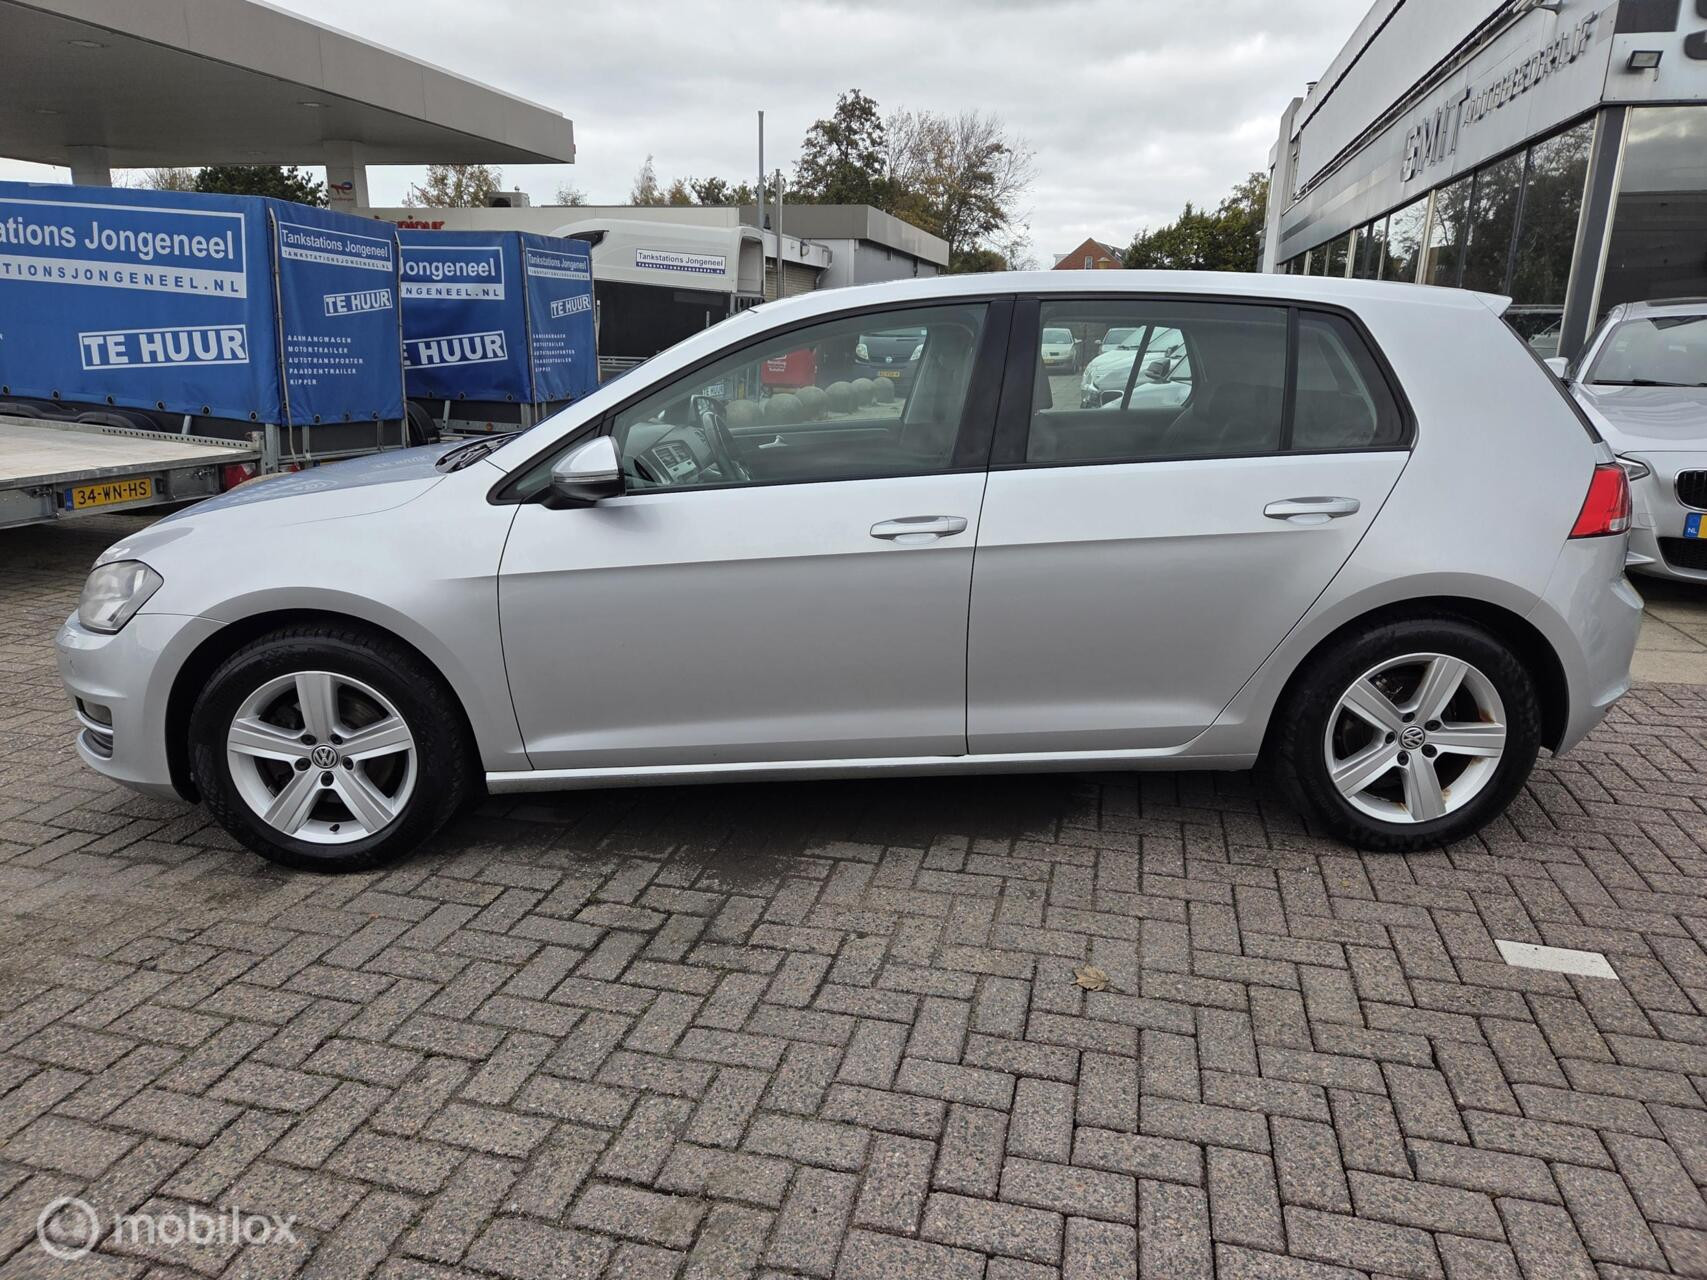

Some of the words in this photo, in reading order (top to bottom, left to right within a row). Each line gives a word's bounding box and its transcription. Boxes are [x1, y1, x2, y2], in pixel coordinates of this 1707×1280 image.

[84, 221, 234, 260] Jongeneel
[281, 229, 343, 251] Tankstations
[345, 241, 389, 257] Jongeneel
[638, 252, 684, 263] Tankstations
[685, 257, 723, 267] Jongeneel
[2, 262, 239, 293] TIONSJONGENEEL.NL
[325, 296, 347, 313] TE
[351, 291, 390, 310] HUUR
[406, 287, 499, 297] NGENEEL.NL
[551, 302, 564, 316] TE
[565, 296, 590, 313] HUUR
[83, 335, 129, 365] TE
[139, 329, 247, 362] HUUR
[418, 335, 505, 365] HUUR
[78, 481, 147, 505] 34-WN-HS
